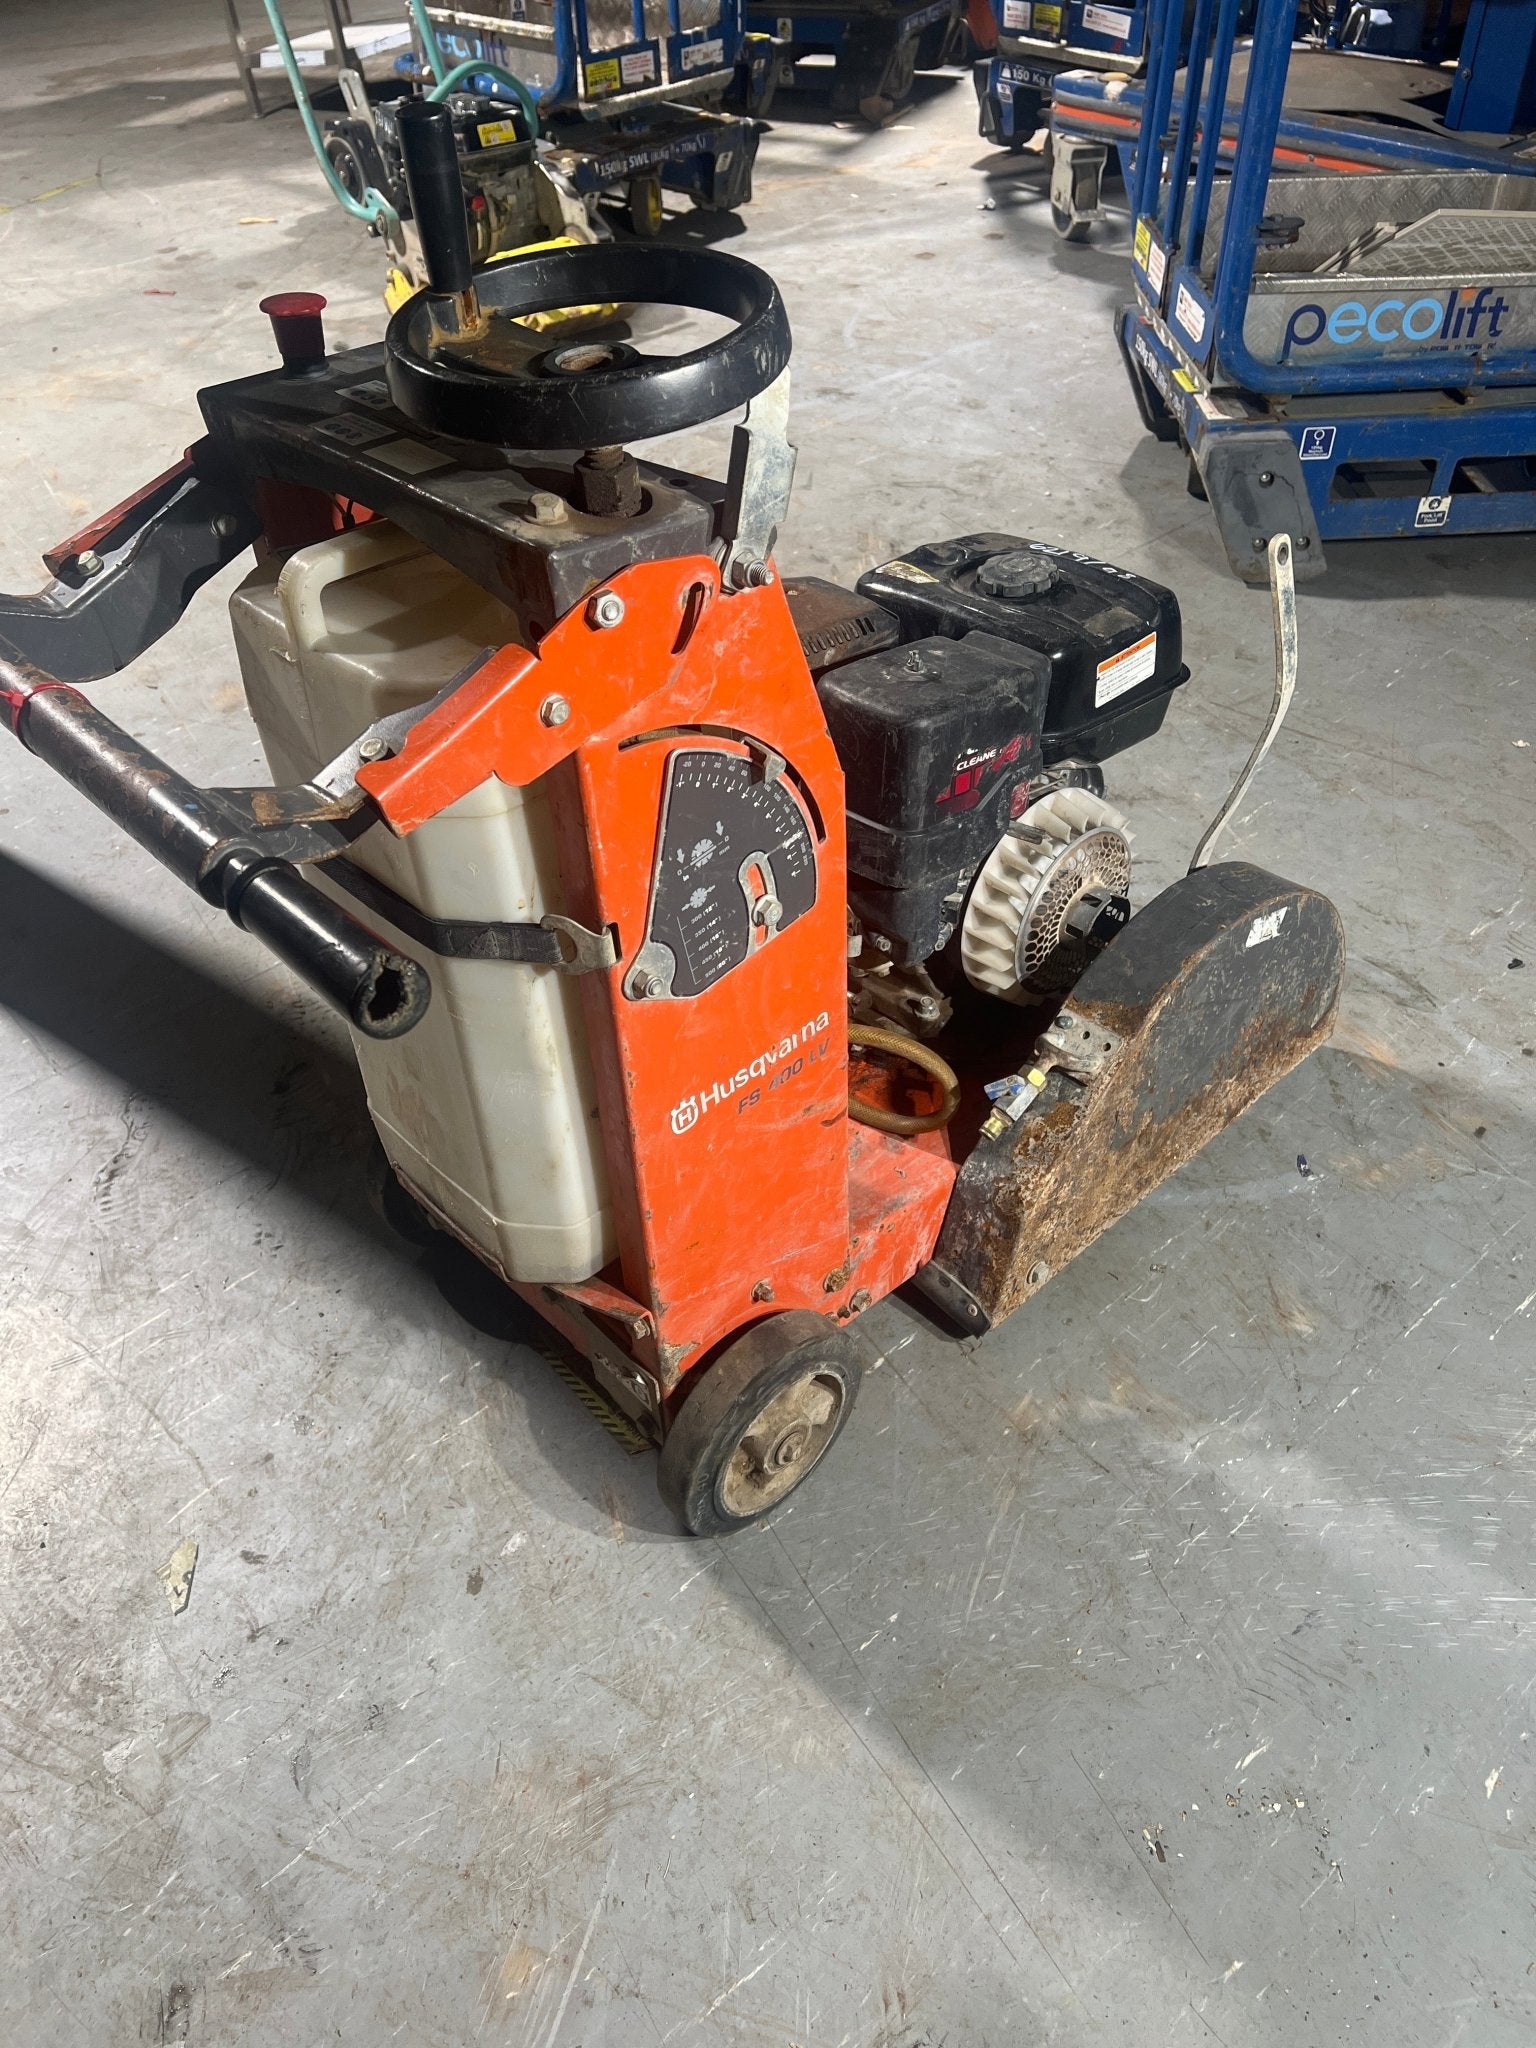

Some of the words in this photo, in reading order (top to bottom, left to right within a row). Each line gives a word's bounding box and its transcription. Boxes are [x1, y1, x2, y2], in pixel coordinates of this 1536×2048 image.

[1012, 69, 1030, 81] 150
[1281, 287, 1510, 361] pecolift
[957, 748, 1003, 771] CLEANE
[701, 1011, 830, 1115] Husqvarna
[738, 1087, 761, 1115] FS
[768, 1057, 804, 1091] 400
[808, 1037, 831, 1063] LV
